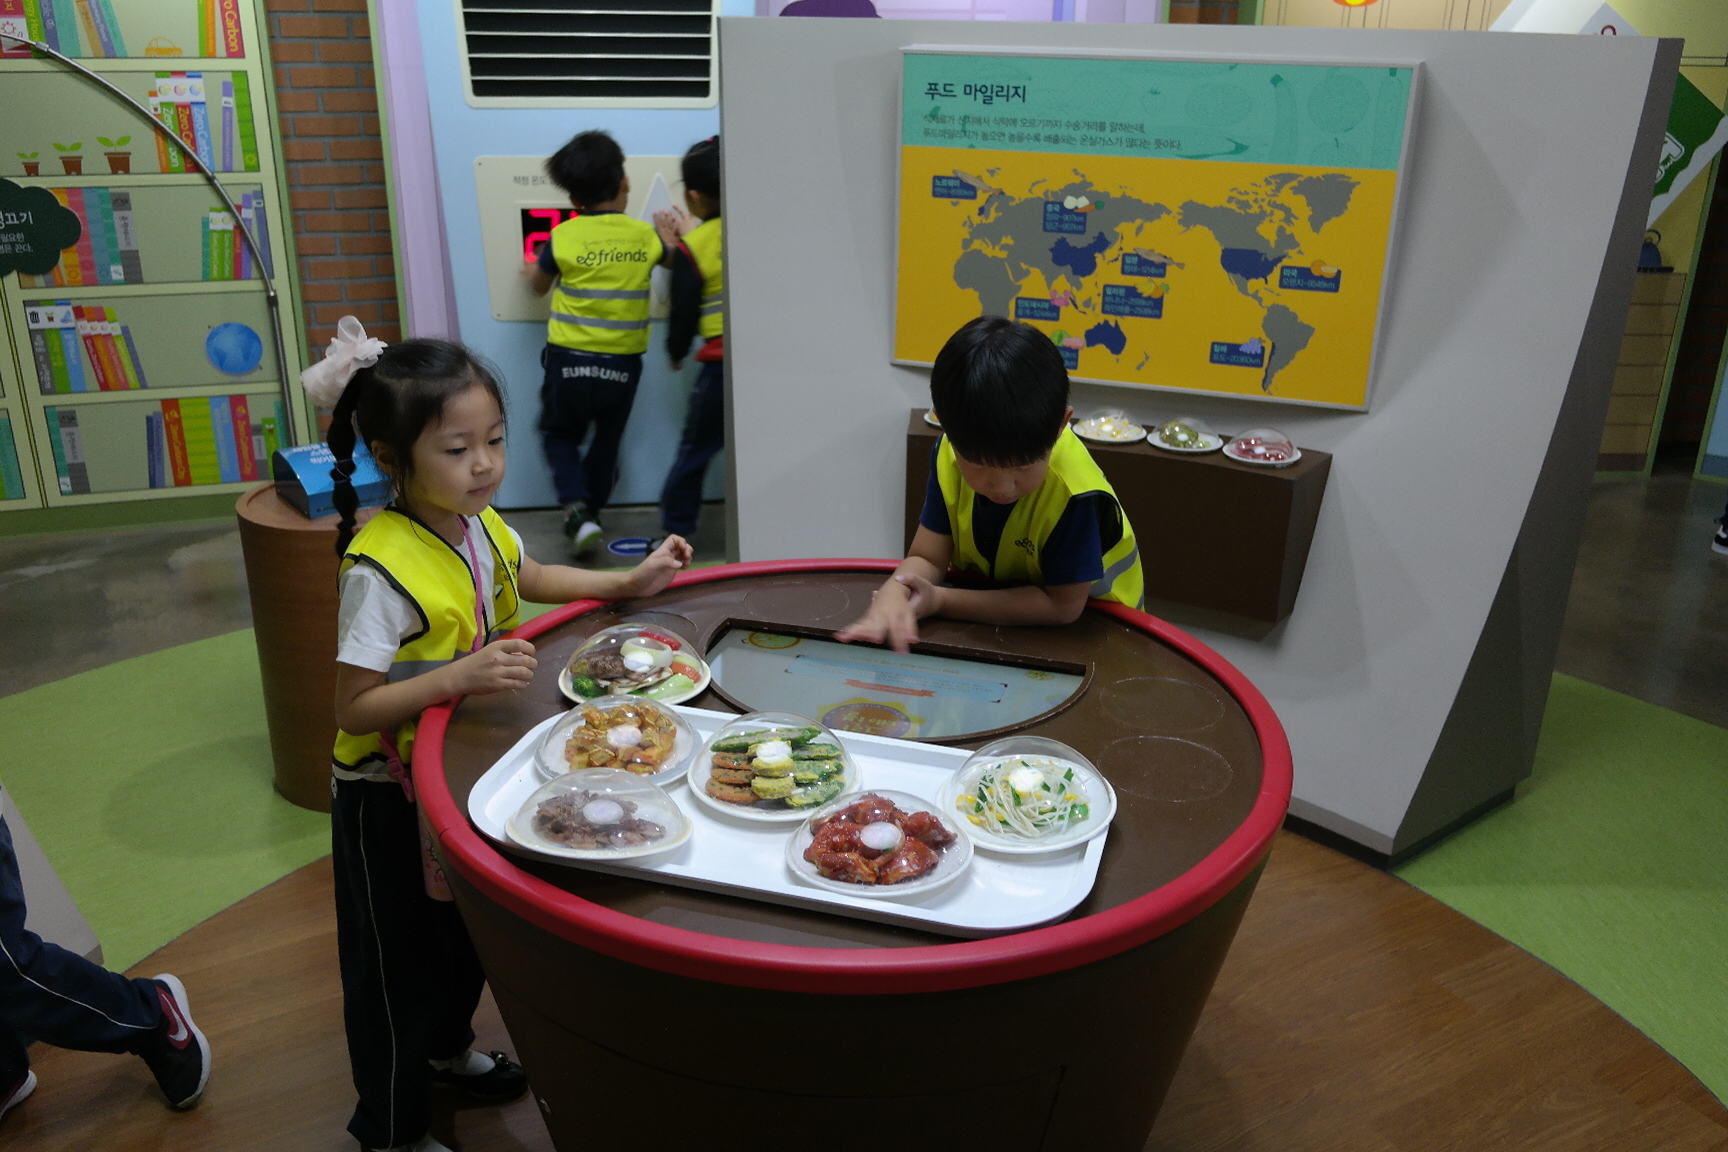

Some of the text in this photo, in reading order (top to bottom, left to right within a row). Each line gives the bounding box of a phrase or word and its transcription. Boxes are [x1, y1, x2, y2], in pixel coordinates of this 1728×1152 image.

[225, 10, 239, 52] Carbon
[924, 82, 1026, 105] 푸드 마일리지
[178, 107, 189, 130] Zero
[1020, 117, 1062, 129] 오르기까지
[1064, 120, 1106, 132] 수송거리를
[194, 107, 211, 166] Zero Carbon
[1283, 268, 1298, 278] 미국
[562, 365, 629, 383] EUNSUNG
